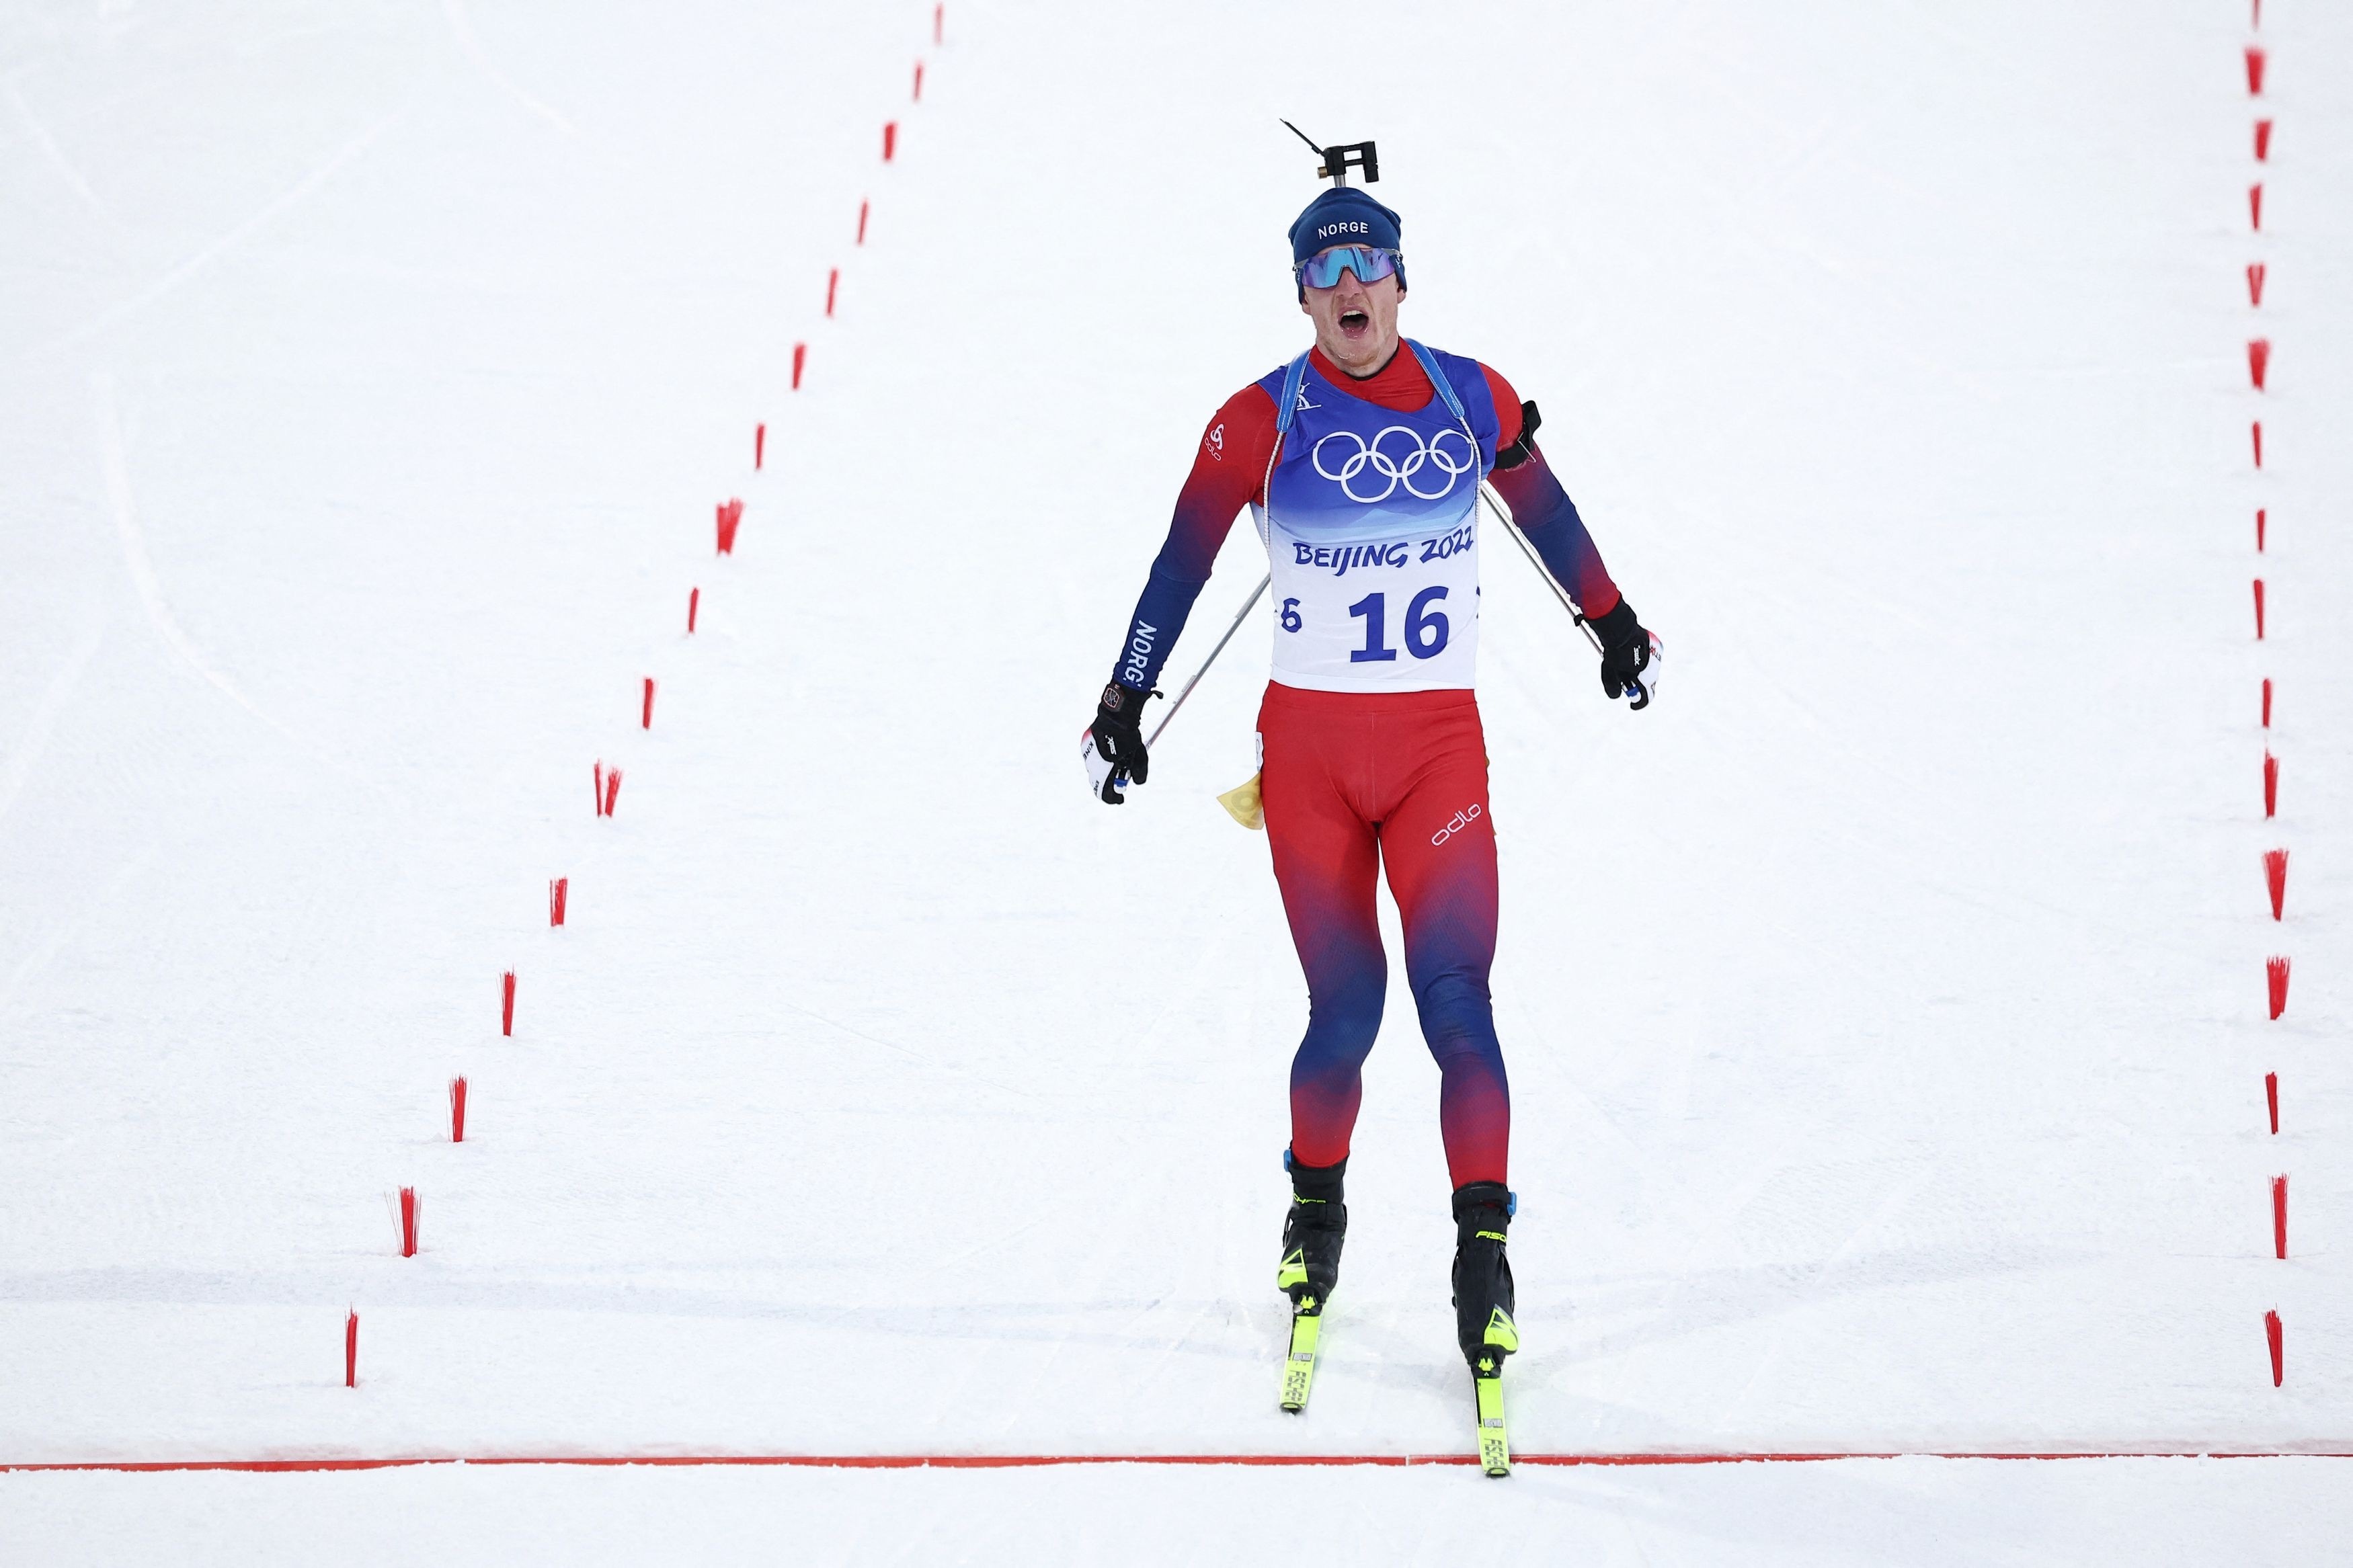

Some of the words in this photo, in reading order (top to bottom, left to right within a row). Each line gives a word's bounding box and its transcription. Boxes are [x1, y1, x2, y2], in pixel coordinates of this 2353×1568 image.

[1318, 222, 1369, 240] NORGE
[1204, 437, 1222, 461] odlo
[1293, 542, 1408, 577] BEIJING
[1419, 526, 1474, 563] 2022
[1274, 597, 1302, 633] 6
[1349, 586, 1449, 663] 16
[1123, 620, 1158, 688] NORG
[1431, 803, 1482, 847] odlo
